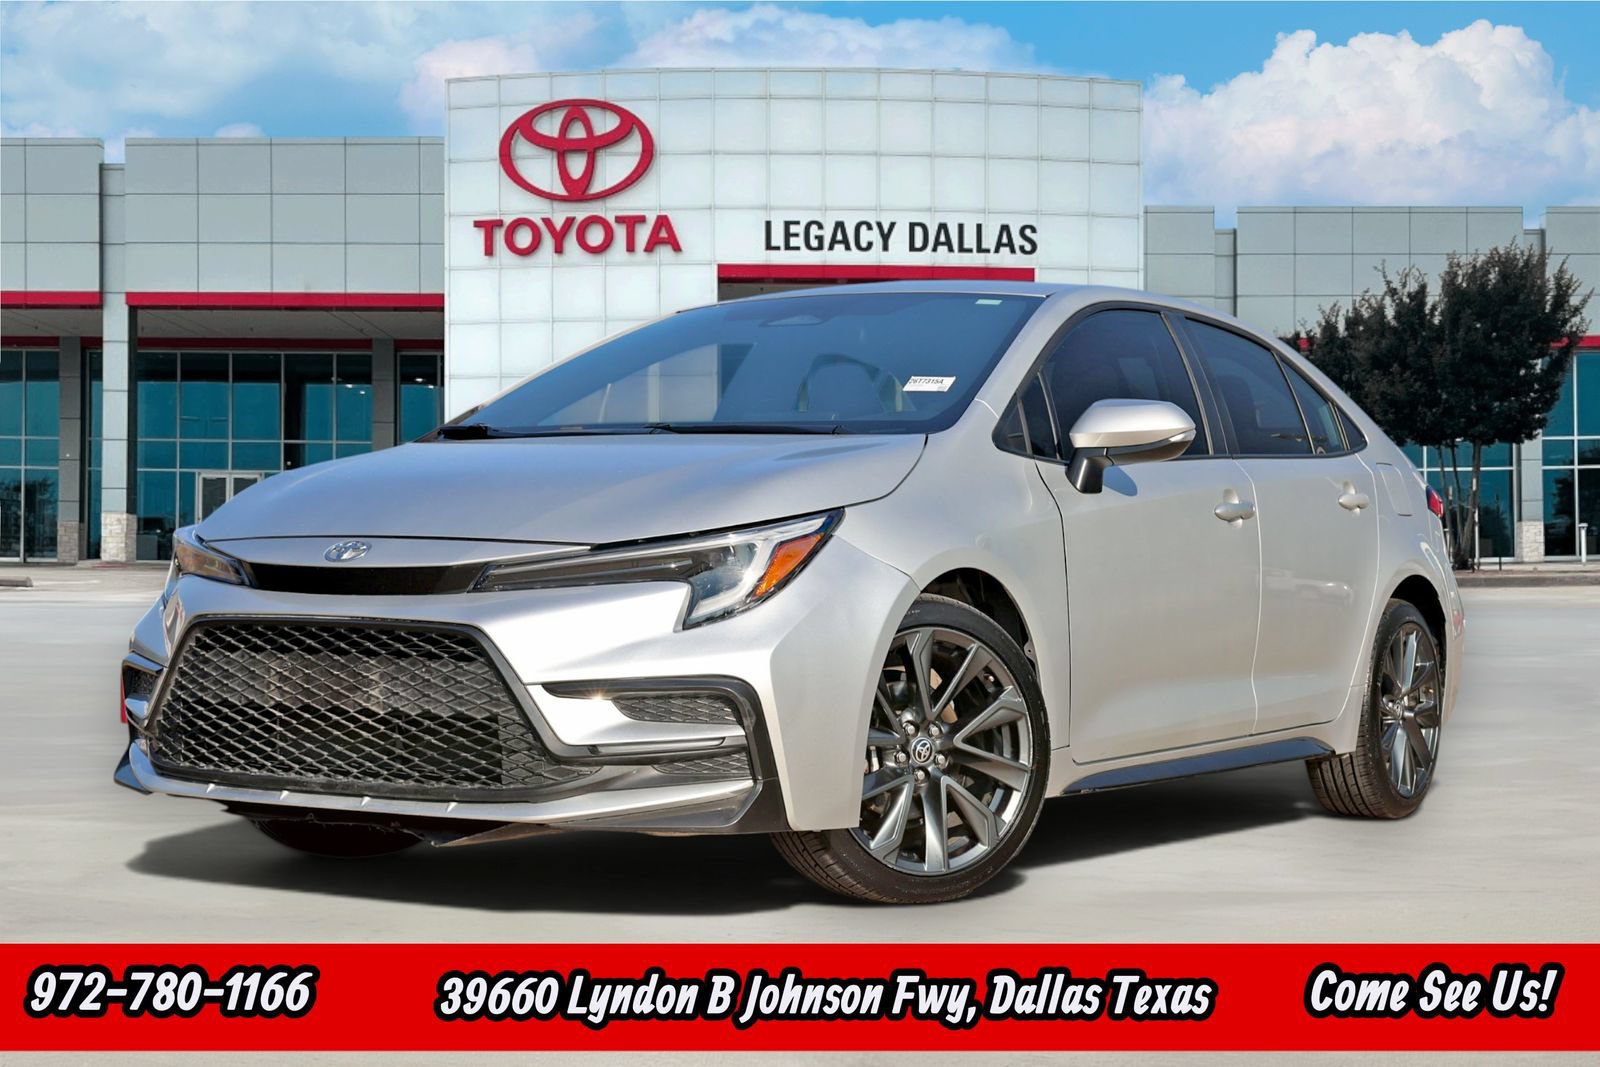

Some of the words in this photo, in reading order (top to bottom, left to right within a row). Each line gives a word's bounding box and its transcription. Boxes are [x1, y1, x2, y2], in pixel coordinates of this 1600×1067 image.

[473, 214, 682, 257] TOYOTA
[765, 220, 897, 252] LEGACY
[908, 222, 1038, 255] DALLAS
